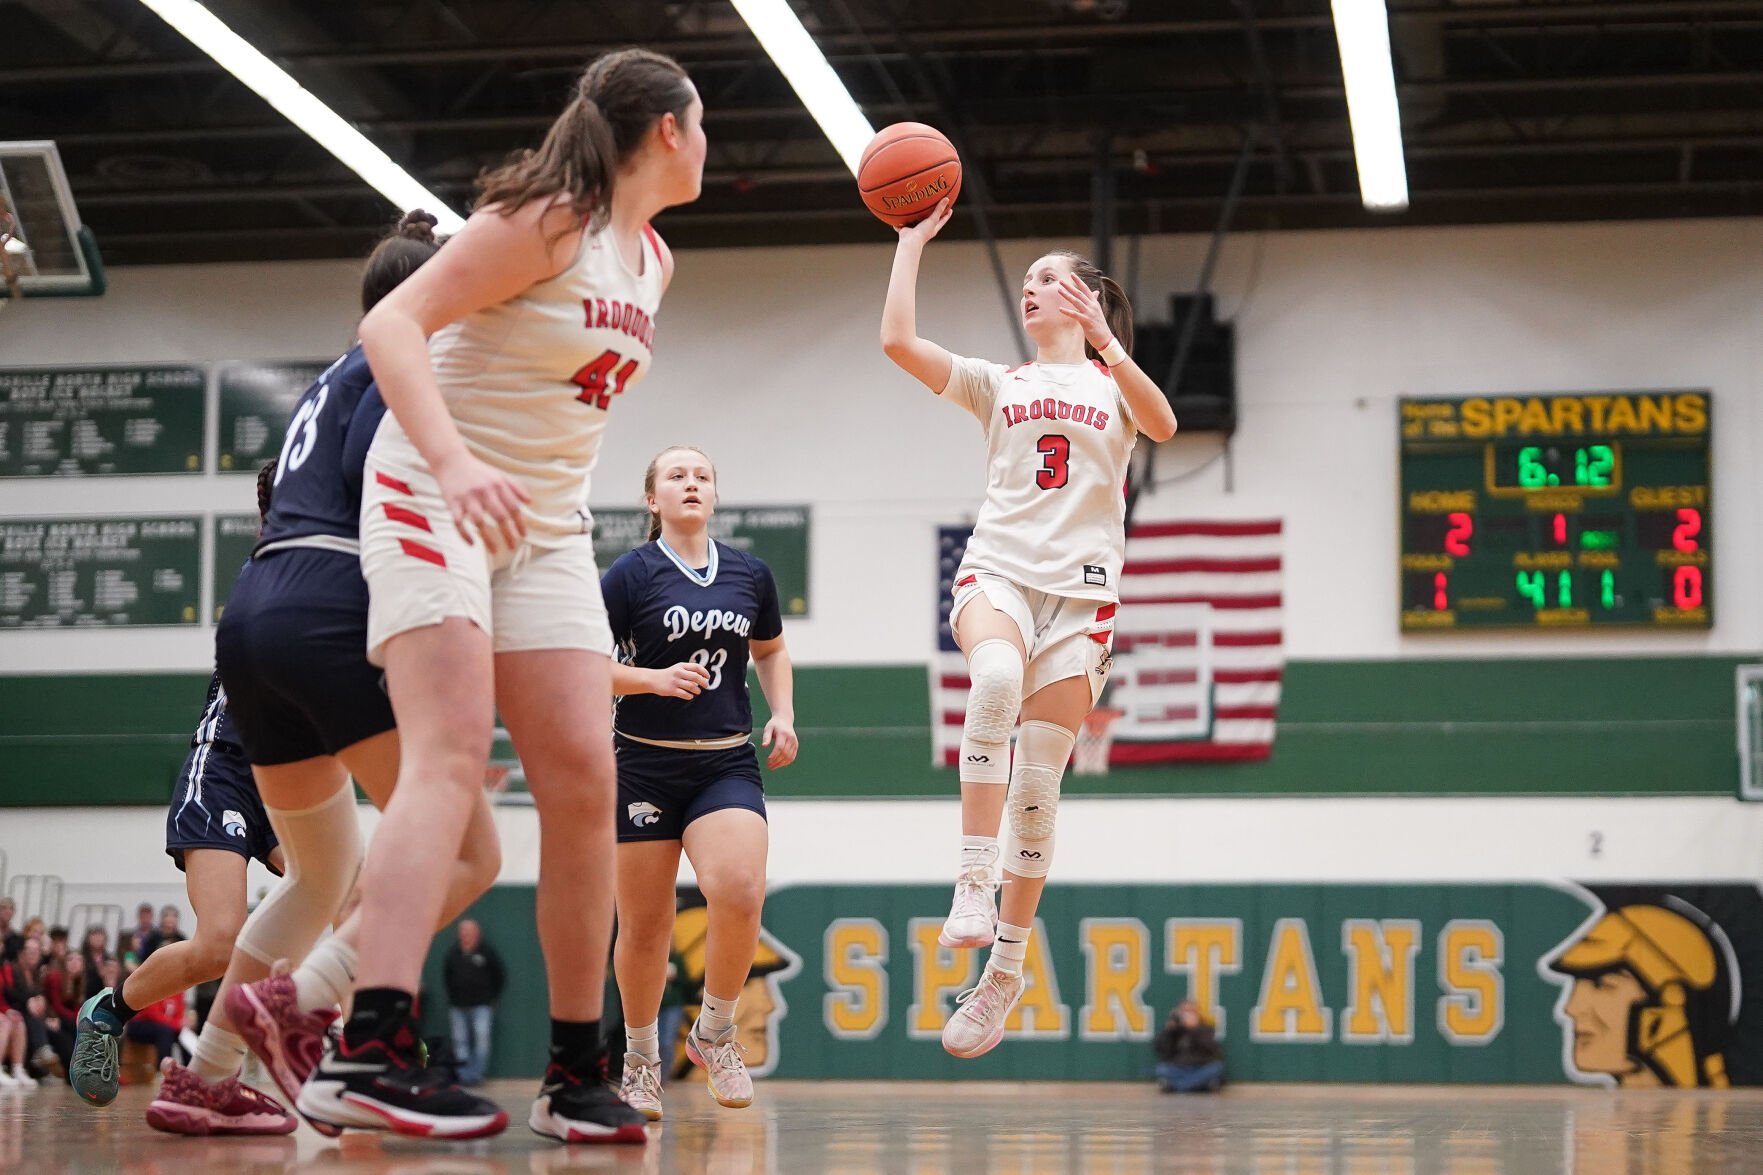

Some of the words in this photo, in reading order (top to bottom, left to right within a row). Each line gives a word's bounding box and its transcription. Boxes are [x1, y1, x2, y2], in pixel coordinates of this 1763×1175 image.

[881, 173, 948, 210] SPALDING
[570, 348, 638, 410] 41
[273, 384, 329, 488] 13
[1002, 398, 1110, 431] IROQUOIS
[1460, 394, 1707, 438] SPARTANS
[1036, 434, 1071, 490] 3
[1445, 512, 1473, 557] 2
[1553, 512, 1567, 545] 1
[1672, 507, 1702, 554] 2
[1434, 572, 1448, 611] 1
[1673, 565, 1703, 611] 0
[663, 605, 752, 642] Depew
[823, 917, 1506, 1046] SPARTANS
